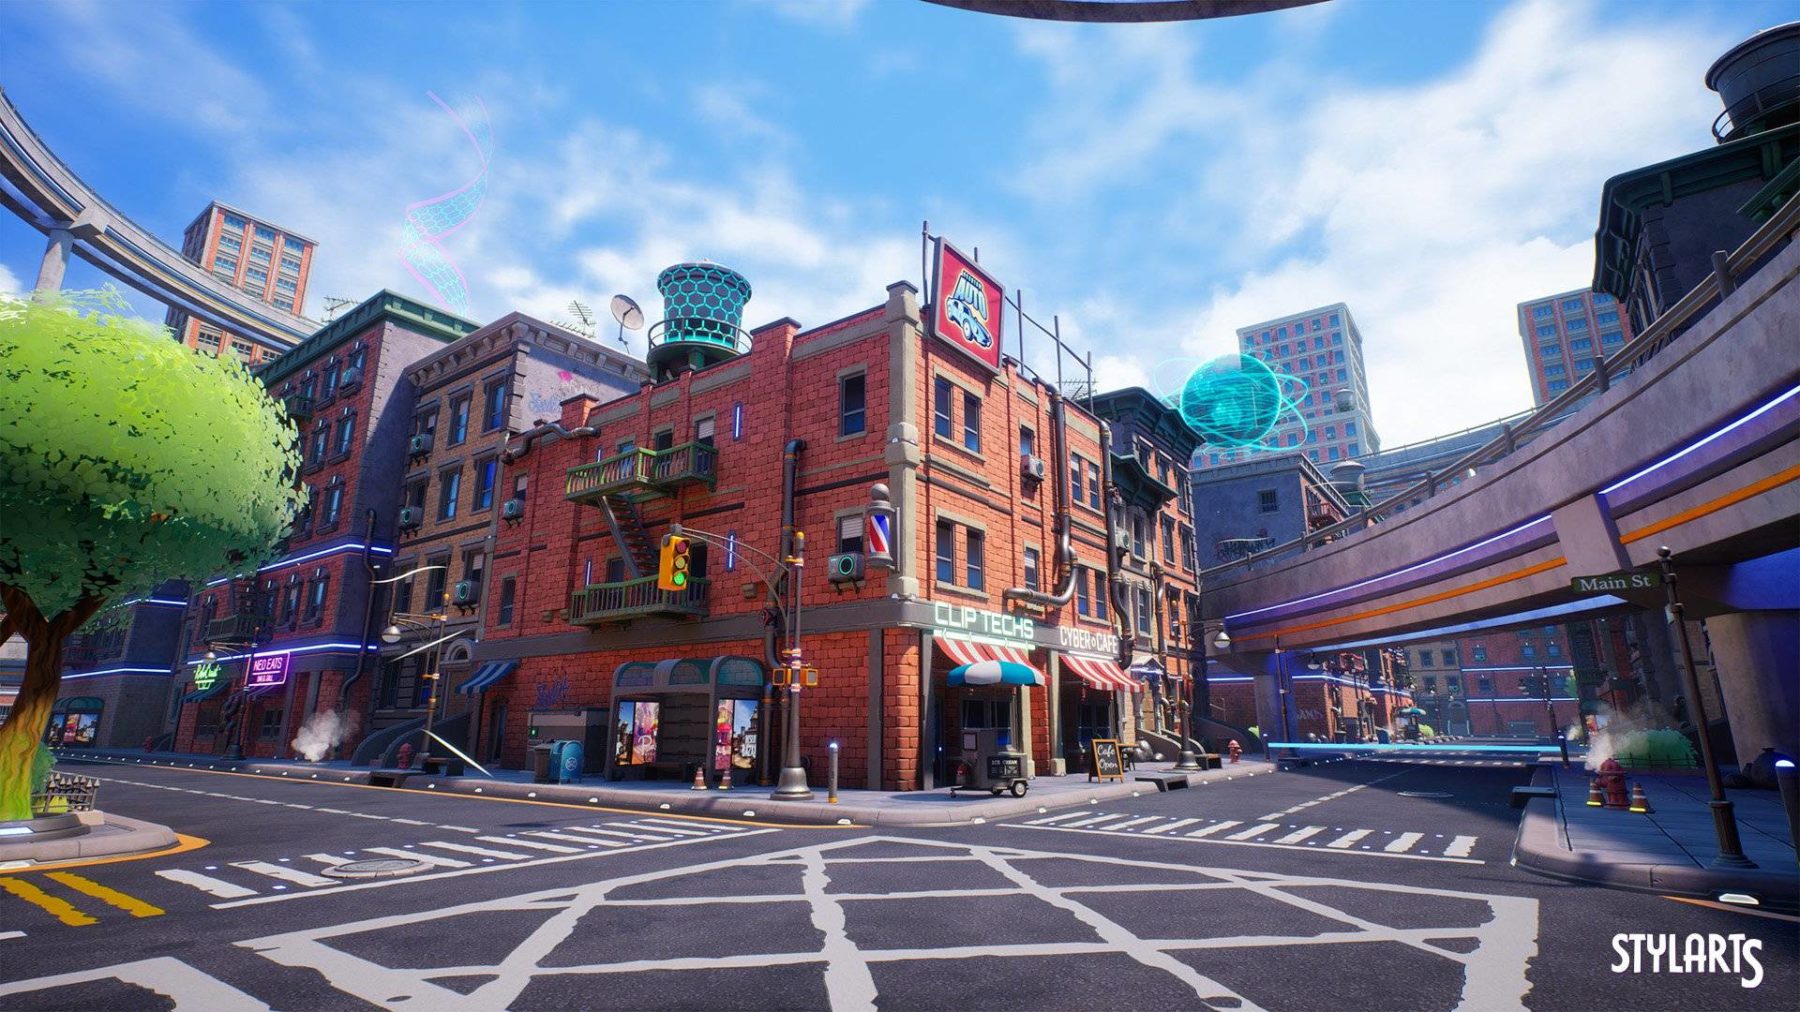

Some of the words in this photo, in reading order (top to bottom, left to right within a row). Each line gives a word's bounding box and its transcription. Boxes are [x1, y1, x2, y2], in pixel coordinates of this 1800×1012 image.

[953, 276, 987, 320] AUTO
[1580, 577, 1626, 591] Main
[1631, 575, 1651, 588] St
[935, 601, 977, 629] CLIP
[980, 610, 1034, 639] TECHS
[1060, 625, 1091, 650] CYBER
[1096, 632, 1119, 654] CAFE
[266, 657, 283, 670] EATS
